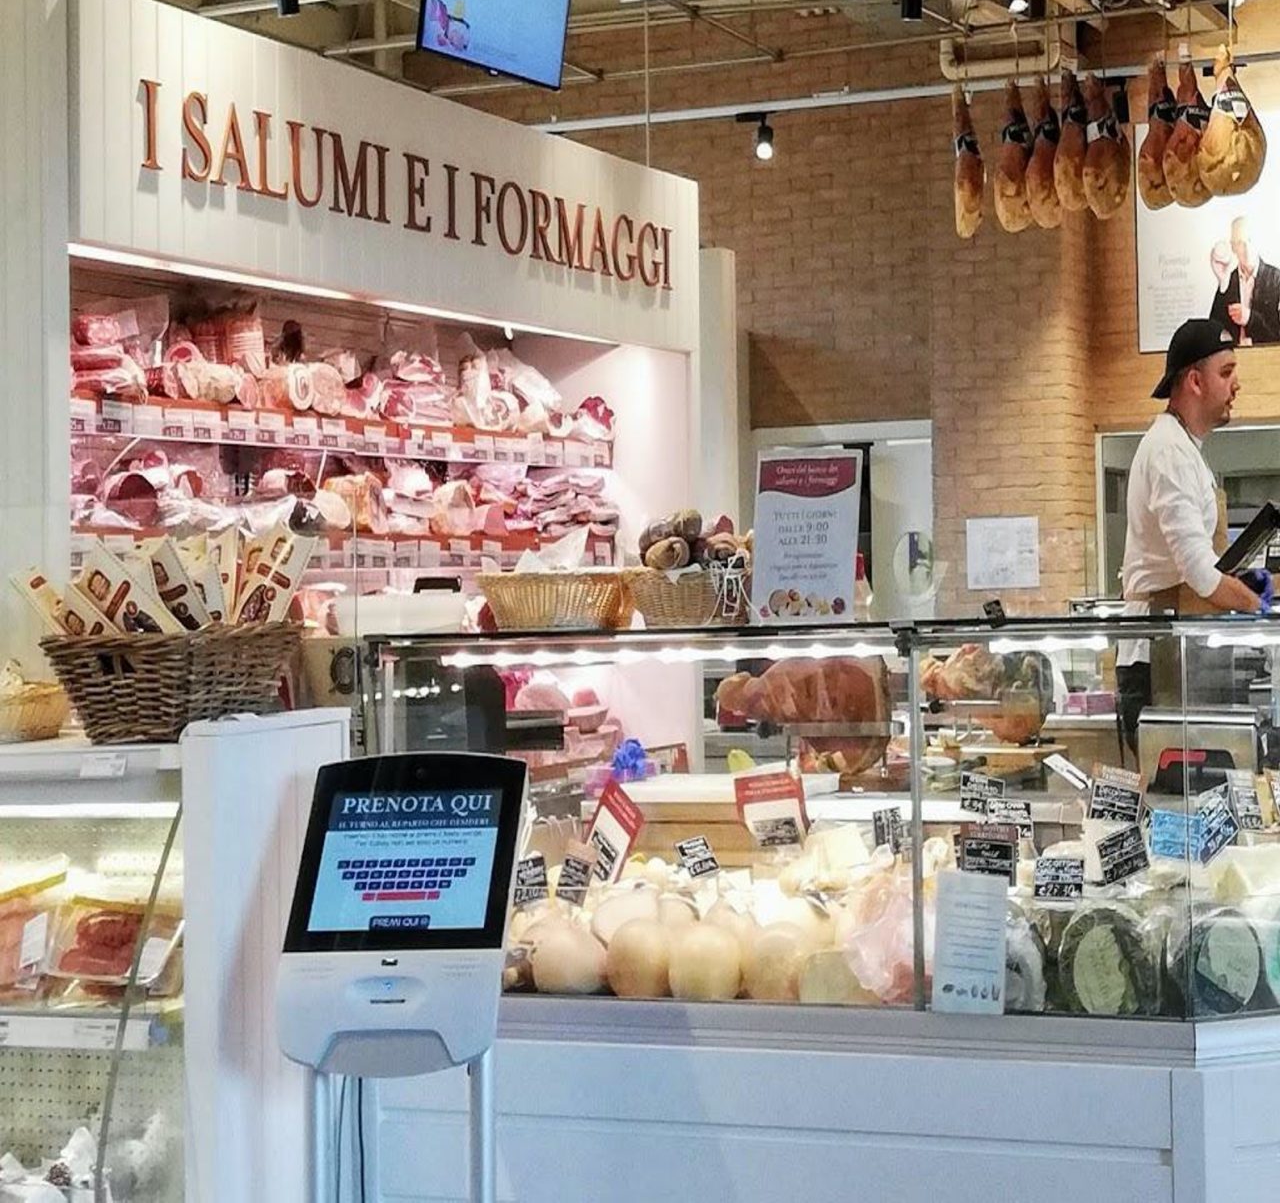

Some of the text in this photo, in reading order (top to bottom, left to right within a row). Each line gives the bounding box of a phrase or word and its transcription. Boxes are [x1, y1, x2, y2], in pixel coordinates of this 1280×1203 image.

[140, 78, 674, 291] I SALUMI E I FORMAGGI
[341, 794, 493, 817] PRENOTA QUI
[350, 821, 378, 829] TURNO
[391, 820, 429, 828] REPARTO
[430, 819, 446, 827] CHE
[449, 818, 490, 826] DESIDERI
[402, 917, 420, 927] QUI
